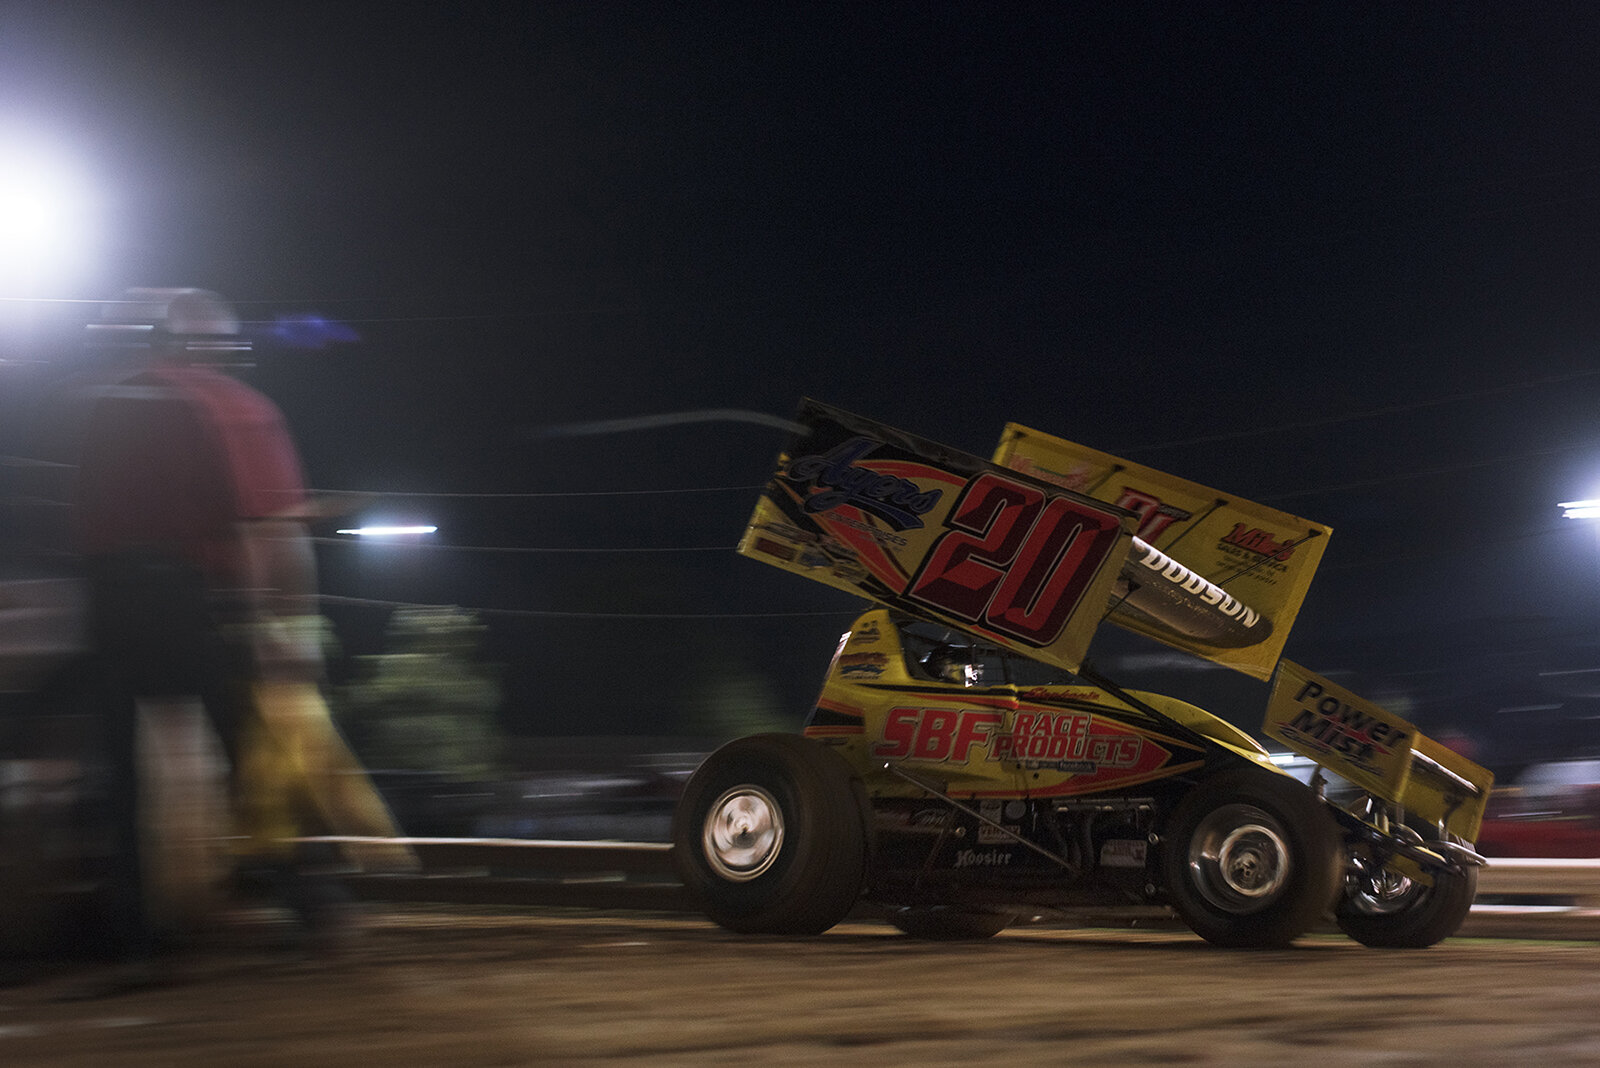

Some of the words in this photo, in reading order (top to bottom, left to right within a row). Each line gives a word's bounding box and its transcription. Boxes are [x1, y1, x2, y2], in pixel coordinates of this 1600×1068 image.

[904, 469, 1123, 647] 20
[1139, 544, 1260, 628] DODSON
[872, 706, 1001, 765] SBF
[1012, 710, 1091, 736] RACE
[1294, 681, 1406, 747] Power
[990, 735, 1140, 765] PRODUCTS
[955, 849, 1012, 868] Hoosier
